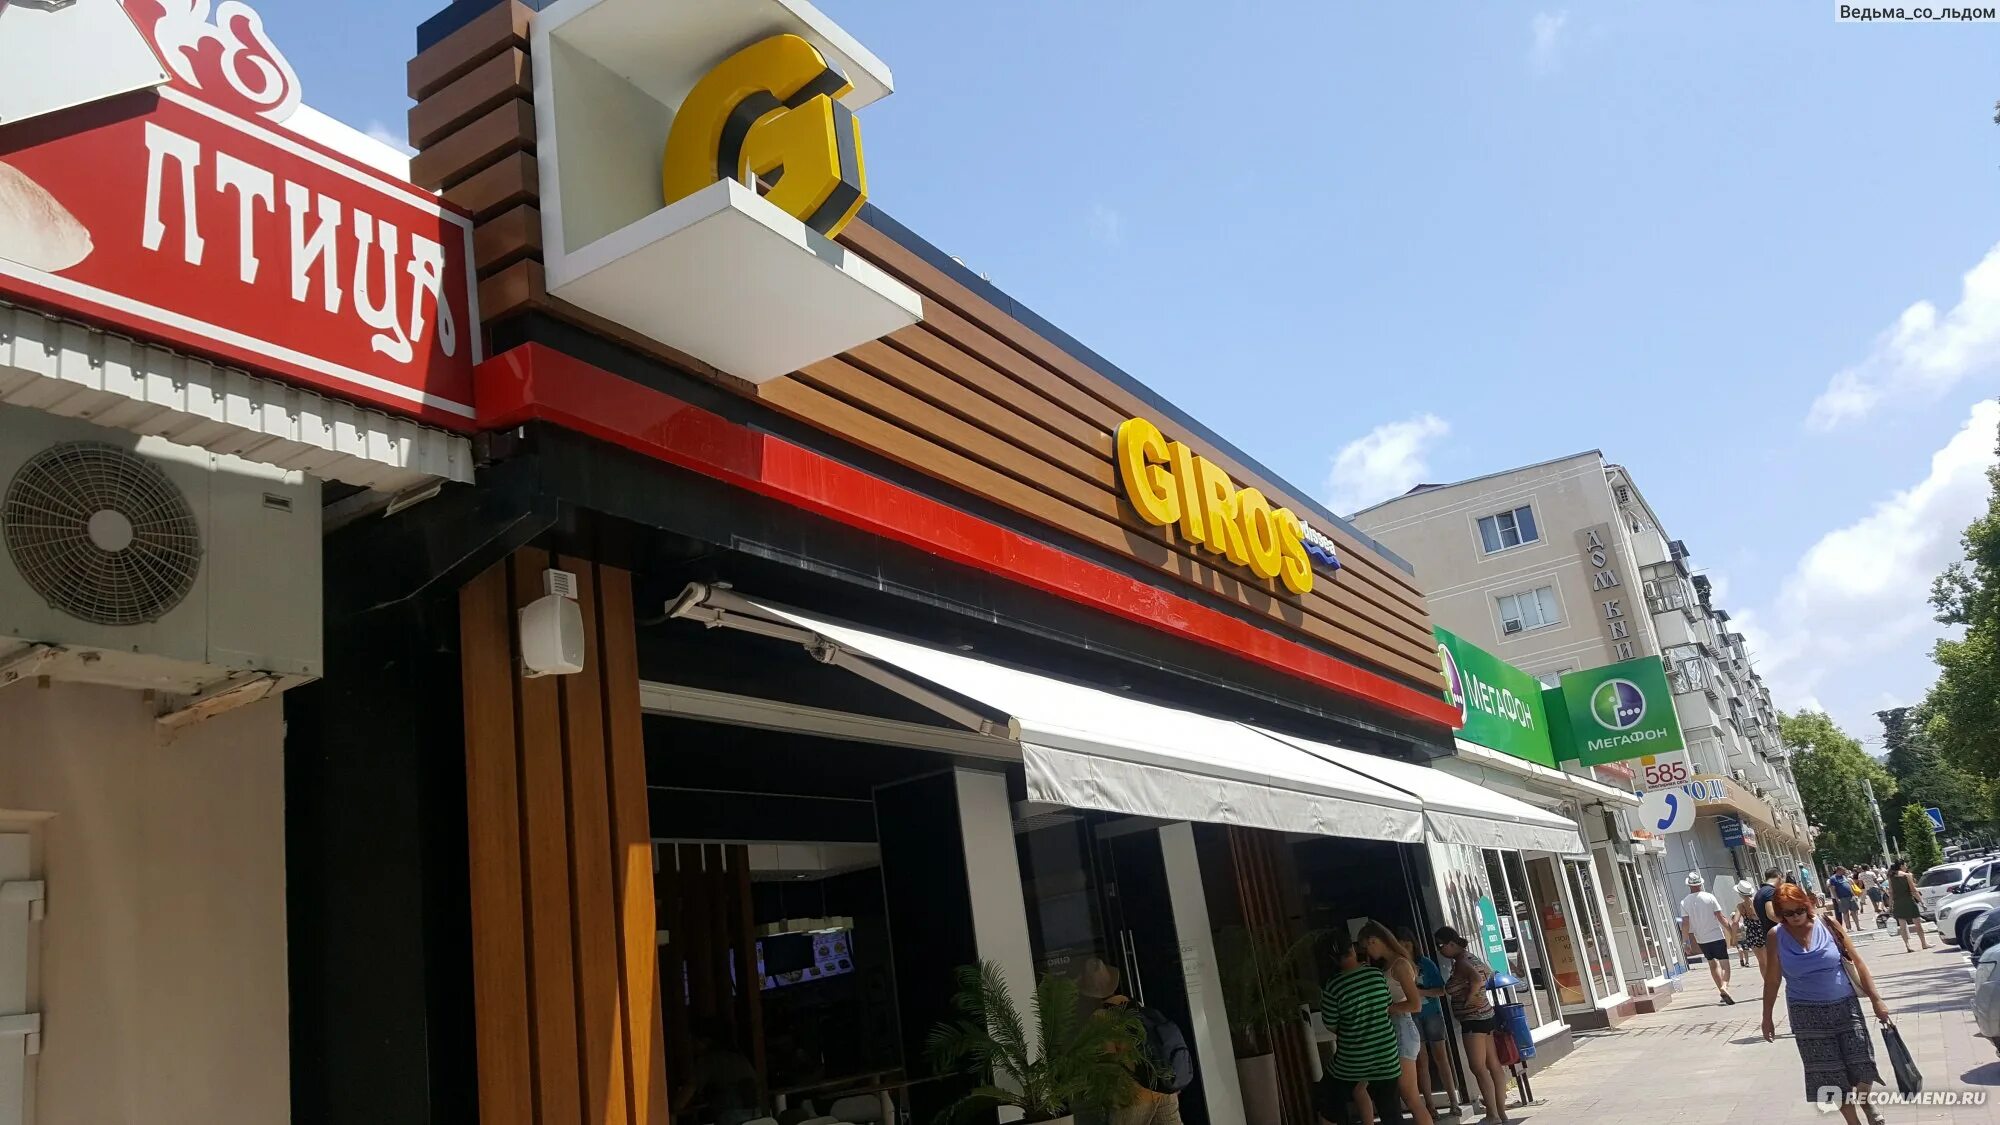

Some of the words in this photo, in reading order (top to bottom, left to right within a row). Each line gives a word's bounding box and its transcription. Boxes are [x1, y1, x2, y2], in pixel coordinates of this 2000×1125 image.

[1114, 417, 1313, 595] GIROS
[1586, 530, 1621, 591] ДОМ
[1645, 762, 1687, 785] 585
